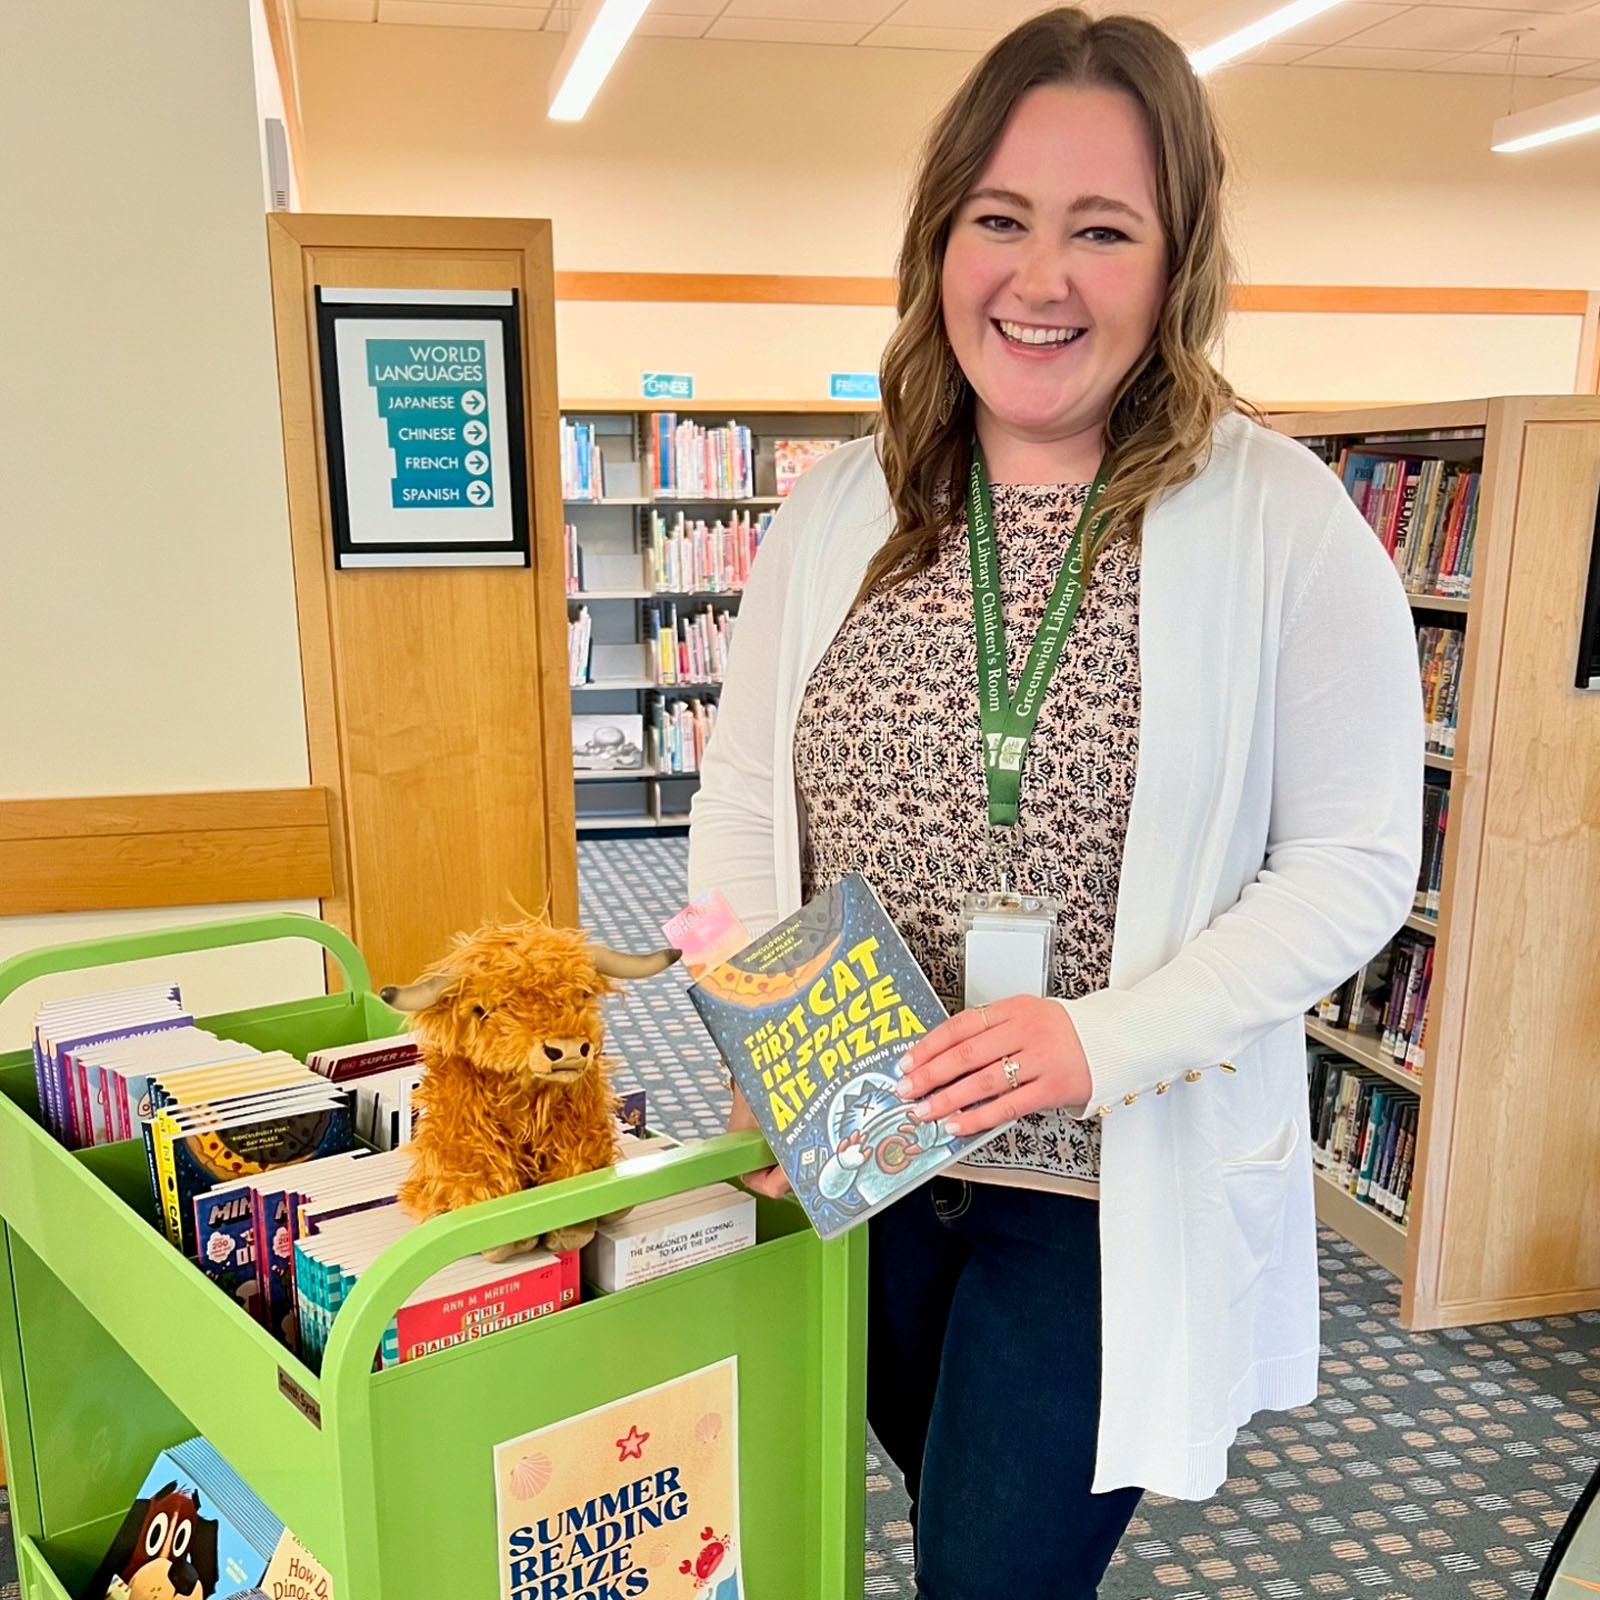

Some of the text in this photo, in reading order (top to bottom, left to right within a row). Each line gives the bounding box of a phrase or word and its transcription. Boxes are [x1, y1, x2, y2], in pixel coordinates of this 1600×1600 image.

[409, 346, 481, 363] WORLD
[374, 364, 483, 382] LANGUAGES
[388, 396, 455, 409] JAPANESE
[398, 427, 456, 441] CHINESE
[405, 457, 458, 469] FRENCH
[402, 488, 459, 501] SPANISH
[1395, 485, 1419, 548] BLUME
[970, 461, 1002, 712] Greenwich Library Children's Room
[1016, 578, 1081, 717] Greenwich Library
[750, 1004, 808, 1070] FIRST
[809, 936, 880, 1016] CAT
[744, 1020, 777, 1048] THE
[762, 975, 901, 1089] IN SPACE
[359, 1053, 397, 1067] SUPER
[769, 1005, 927, 1132] ATE PIZZA
[786, 1040, 920, 1145] MAC BARNETT SHAWN HAR
[169, 1205, 181, 1240] CAT
[208, 1197, 253, 1226] MIN
[630, 1248, 643, 1258] THE
[645, 1234, 689, 1254] DRAGONETS
[690, 1229, 703, 1239] ARE
[659, 1234, 719, 1257] TO SAVE THE DAY
[443, 1301, 465, 1314] ANN
[484, 1282, 521, 1300] MARTIN
[468, 1303, 503, 1324] THE
[508, 1466, 682, 1558] SUMMER
[509, 1492, 689, 1590] READING
[288, 1557, 317, 1585] How
